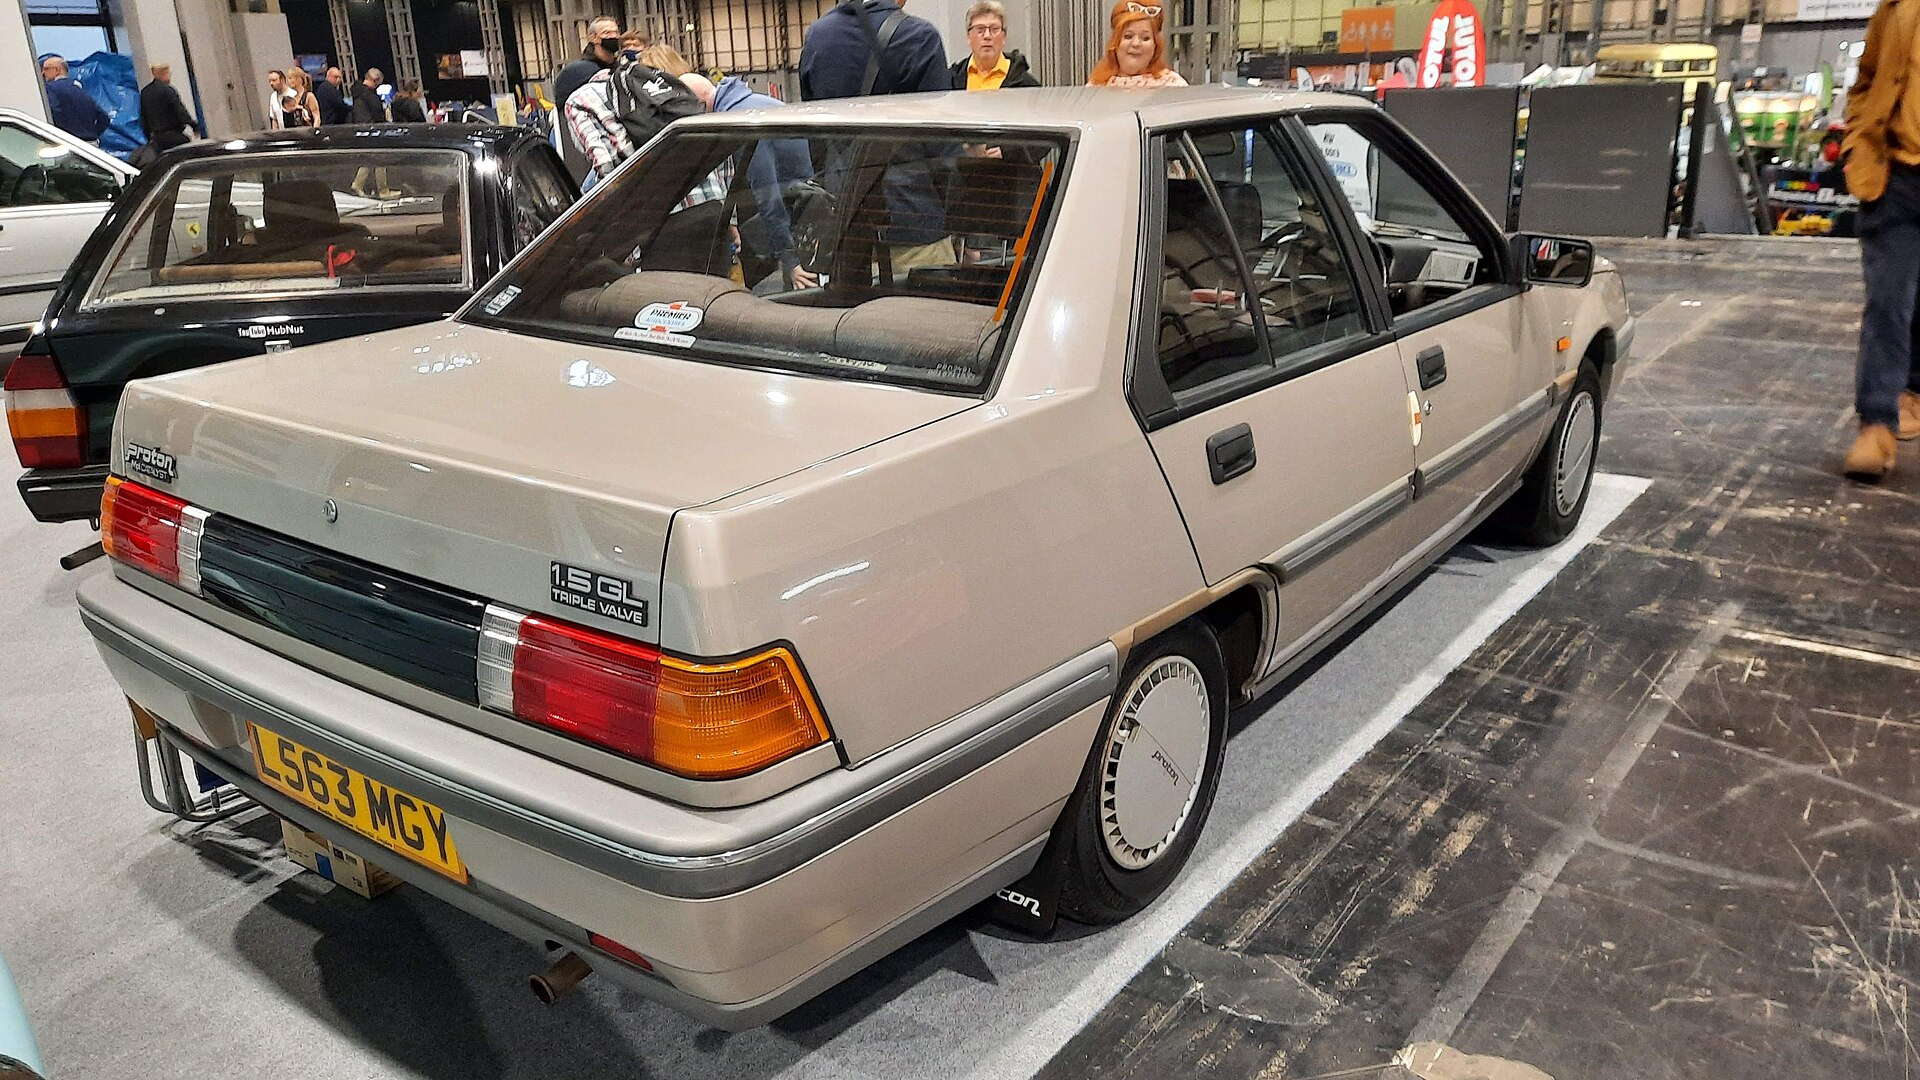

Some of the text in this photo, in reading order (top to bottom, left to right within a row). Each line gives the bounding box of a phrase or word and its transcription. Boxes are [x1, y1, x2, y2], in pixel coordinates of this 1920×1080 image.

[1423, 15, 1450, 88] OTUL
[266, 324, 305, 335] HubNut
[650, 309, 692, 320] PREMIER
[140, 463, 168, 480] CATALYST
[551, 563, 643, 609] 1.5 GL
[552, 587, 643, 625] TRIPLE VALVE
[252, 725, 357, 819] L563
[363, 776, 449, 865] MGY
